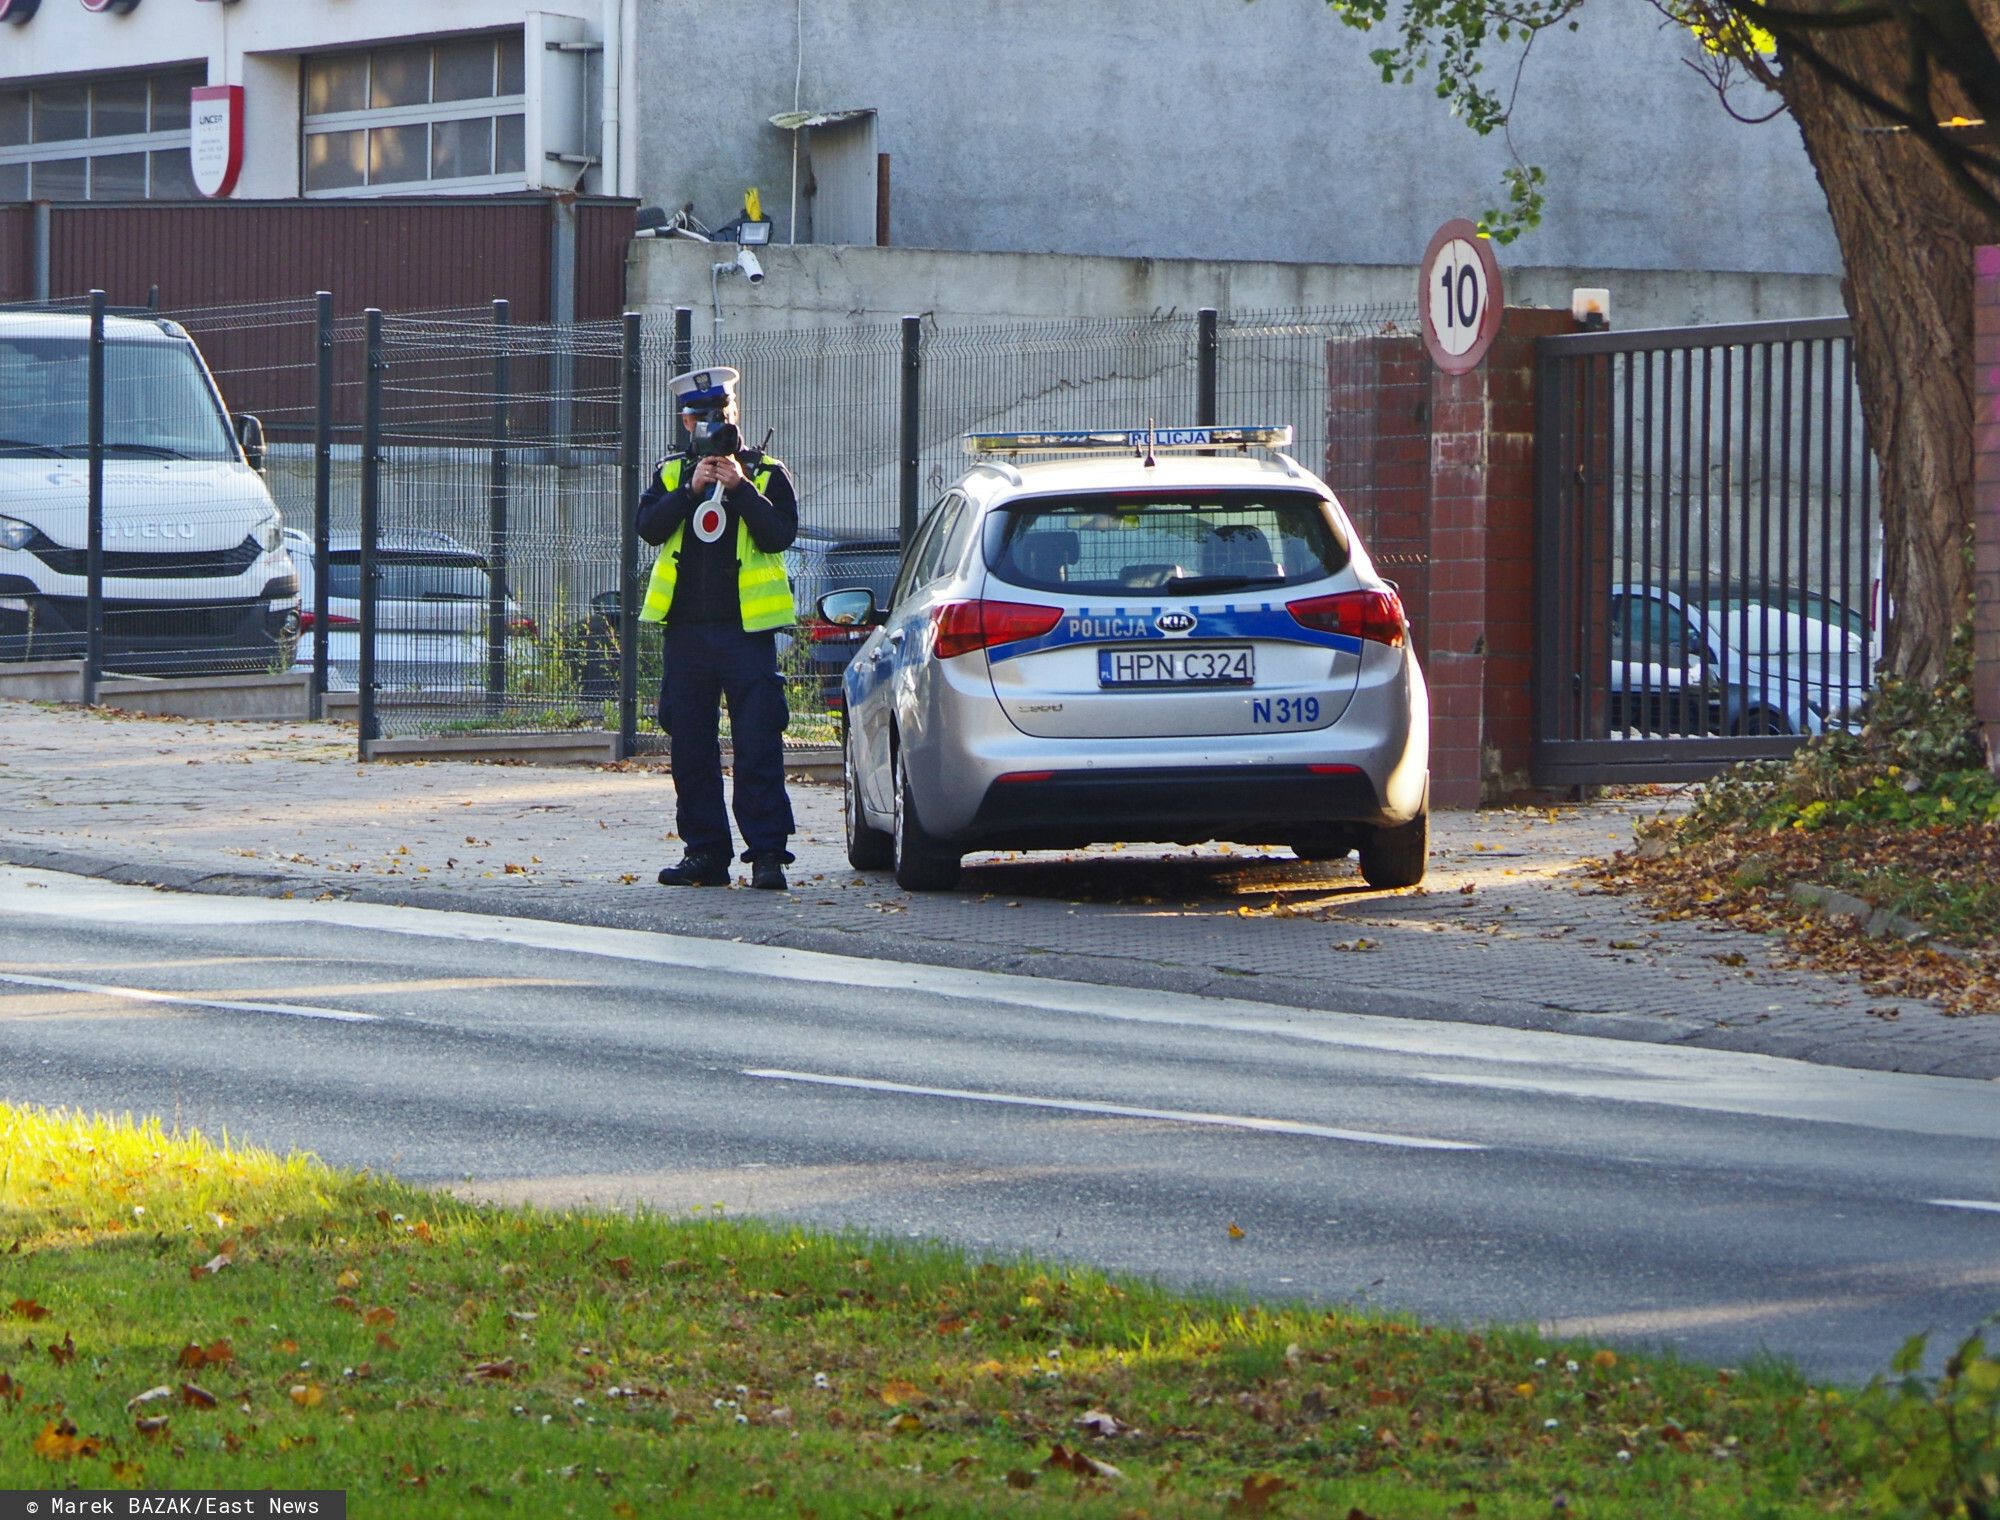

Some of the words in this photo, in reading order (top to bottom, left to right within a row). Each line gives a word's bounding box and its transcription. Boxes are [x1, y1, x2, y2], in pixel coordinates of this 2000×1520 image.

[1441, 264, 1478, 328] 10
[108, 522, 195, 539] IVECO
[1069, 618, 1147, 637] POLICJA
[1162, 615, 1189, 628] KIA
[1101, 671, 1111, 679] PL
[1116, 654, 1174, 680] HPN
[1184, 652, 1247, 679] C324
[1253, 699, 1271, 723] N
[1276, 697, 1319, 723] 319
